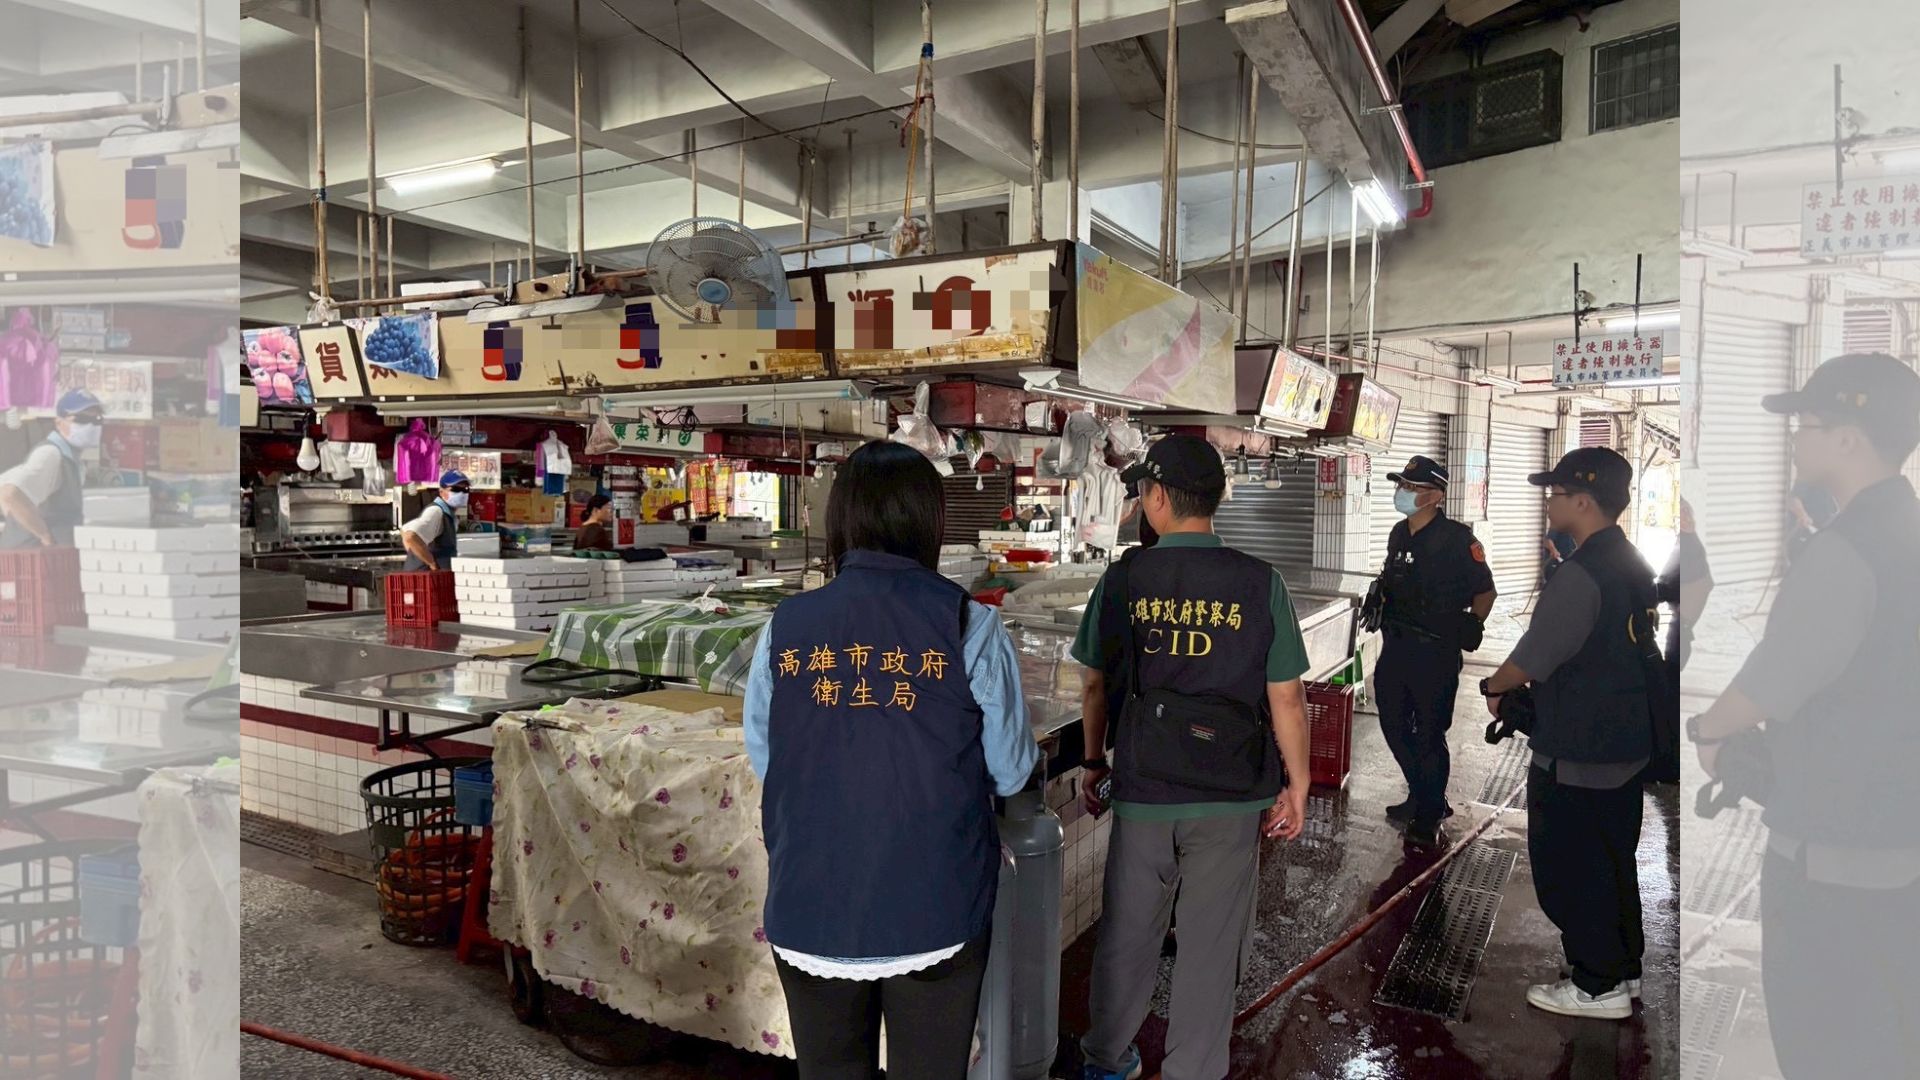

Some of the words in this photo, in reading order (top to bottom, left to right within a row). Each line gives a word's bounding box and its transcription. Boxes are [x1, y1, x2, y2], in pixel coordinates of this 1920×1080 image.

[1556, 336, 1661, 357] 禁止使用擴音器
[1562, 352, 1653, 371] 違者強制執行
[316, 342, 347, 383] 貨
[1554, 367, 1660, 384] 正義市場管理委員會
[1129, 597, 1242, 631] 雄市政府警察局
[1144, 628, 1212, 656] CID
[777, 642, 949, 680] 高雄市政府
[811, 676, 916, 712] 衛生局
